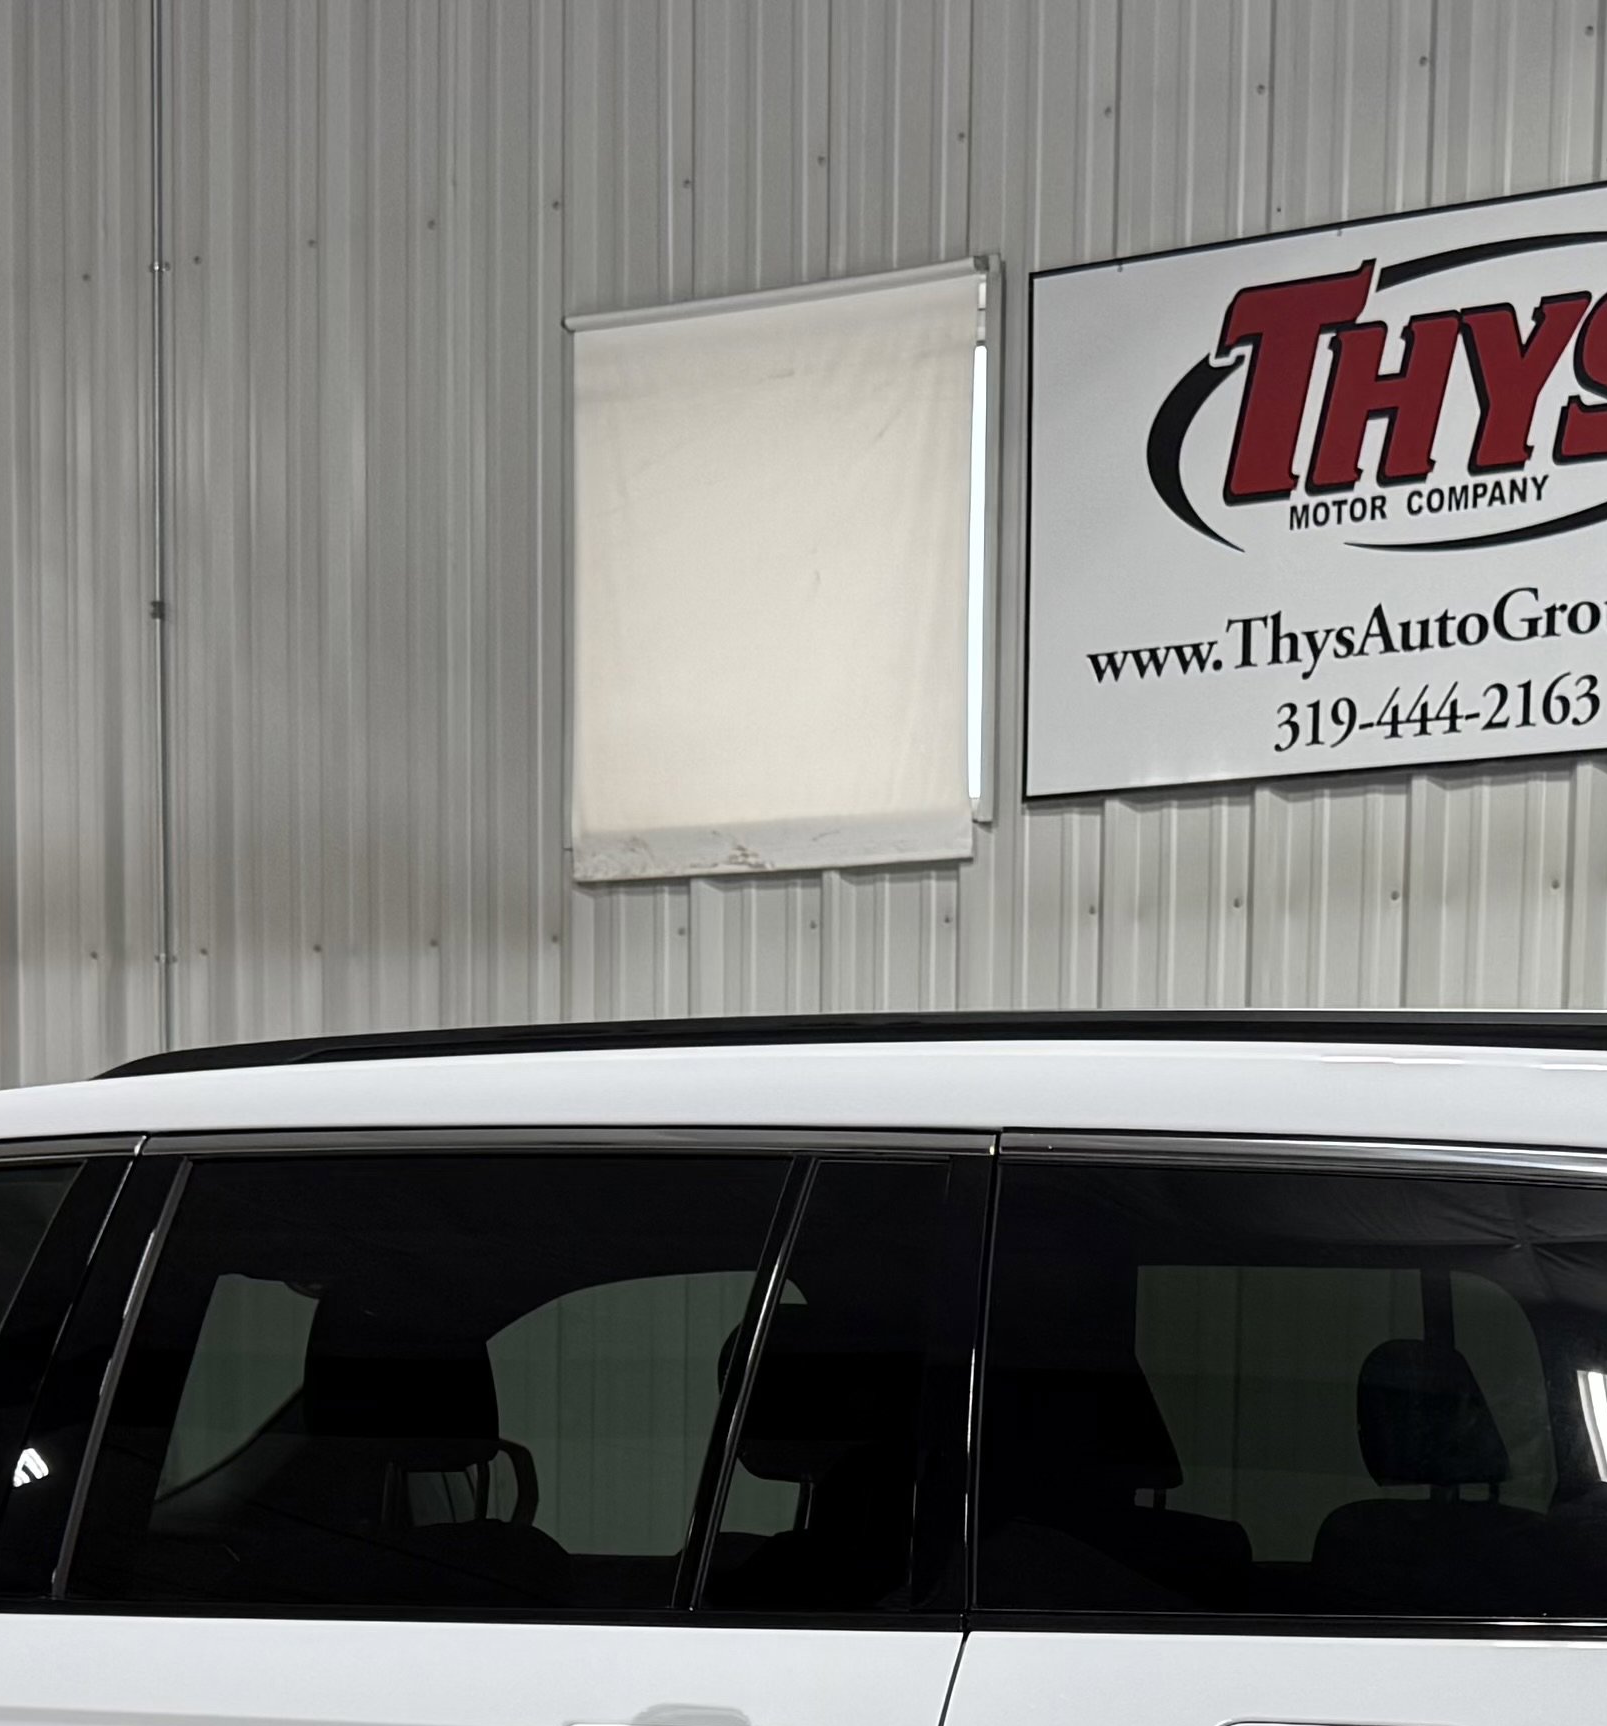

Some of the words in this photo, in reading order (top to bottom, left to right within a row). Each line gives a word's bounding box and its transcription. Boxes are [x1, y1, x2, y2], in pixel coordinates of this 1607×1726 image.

[1287, 494, 1388, 532] MOTOR
[1406, 474, 1550, 517] COMPANY
[1273, 672, 1601, 751] 319-444-2163
